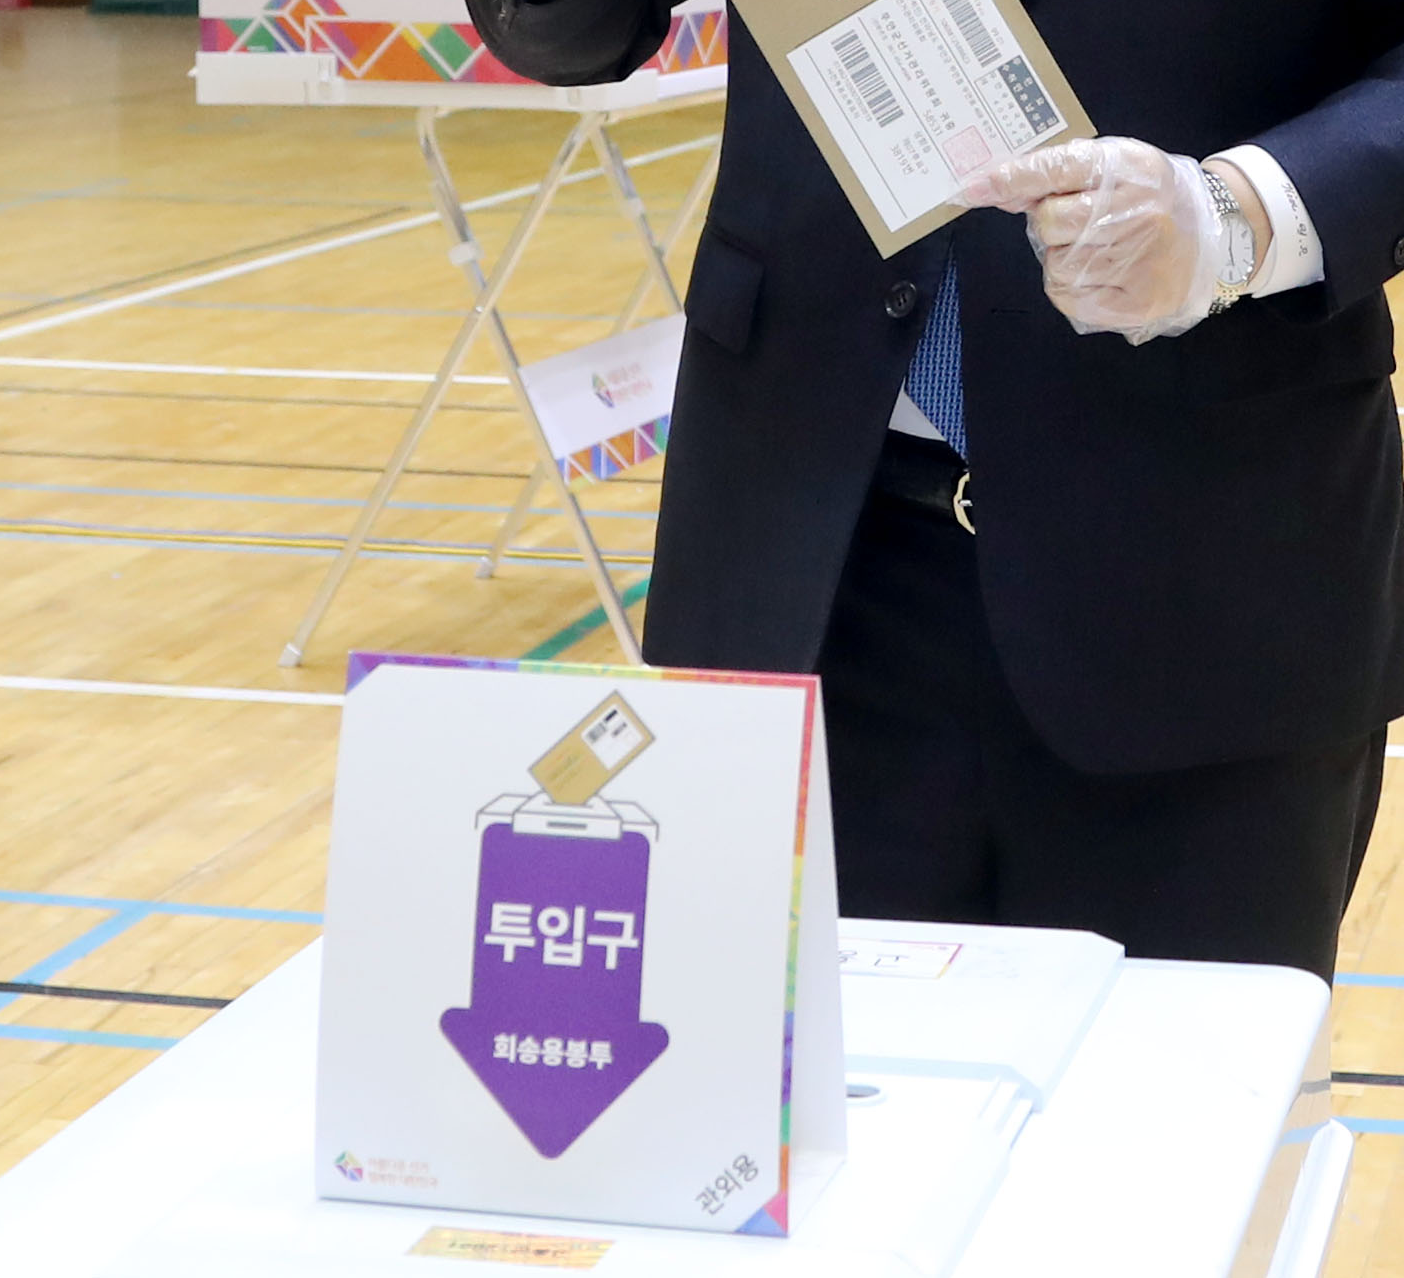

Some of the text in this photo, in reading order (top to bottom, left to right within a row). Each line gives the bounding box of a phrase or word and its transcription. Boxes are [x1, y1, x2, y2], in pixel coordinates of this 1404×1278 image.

[484, 902, 639, 970] 투입구
[493, 1032, 613, 1070] 회송용봉투
[695, 1154, 758, 1215] 관외용
